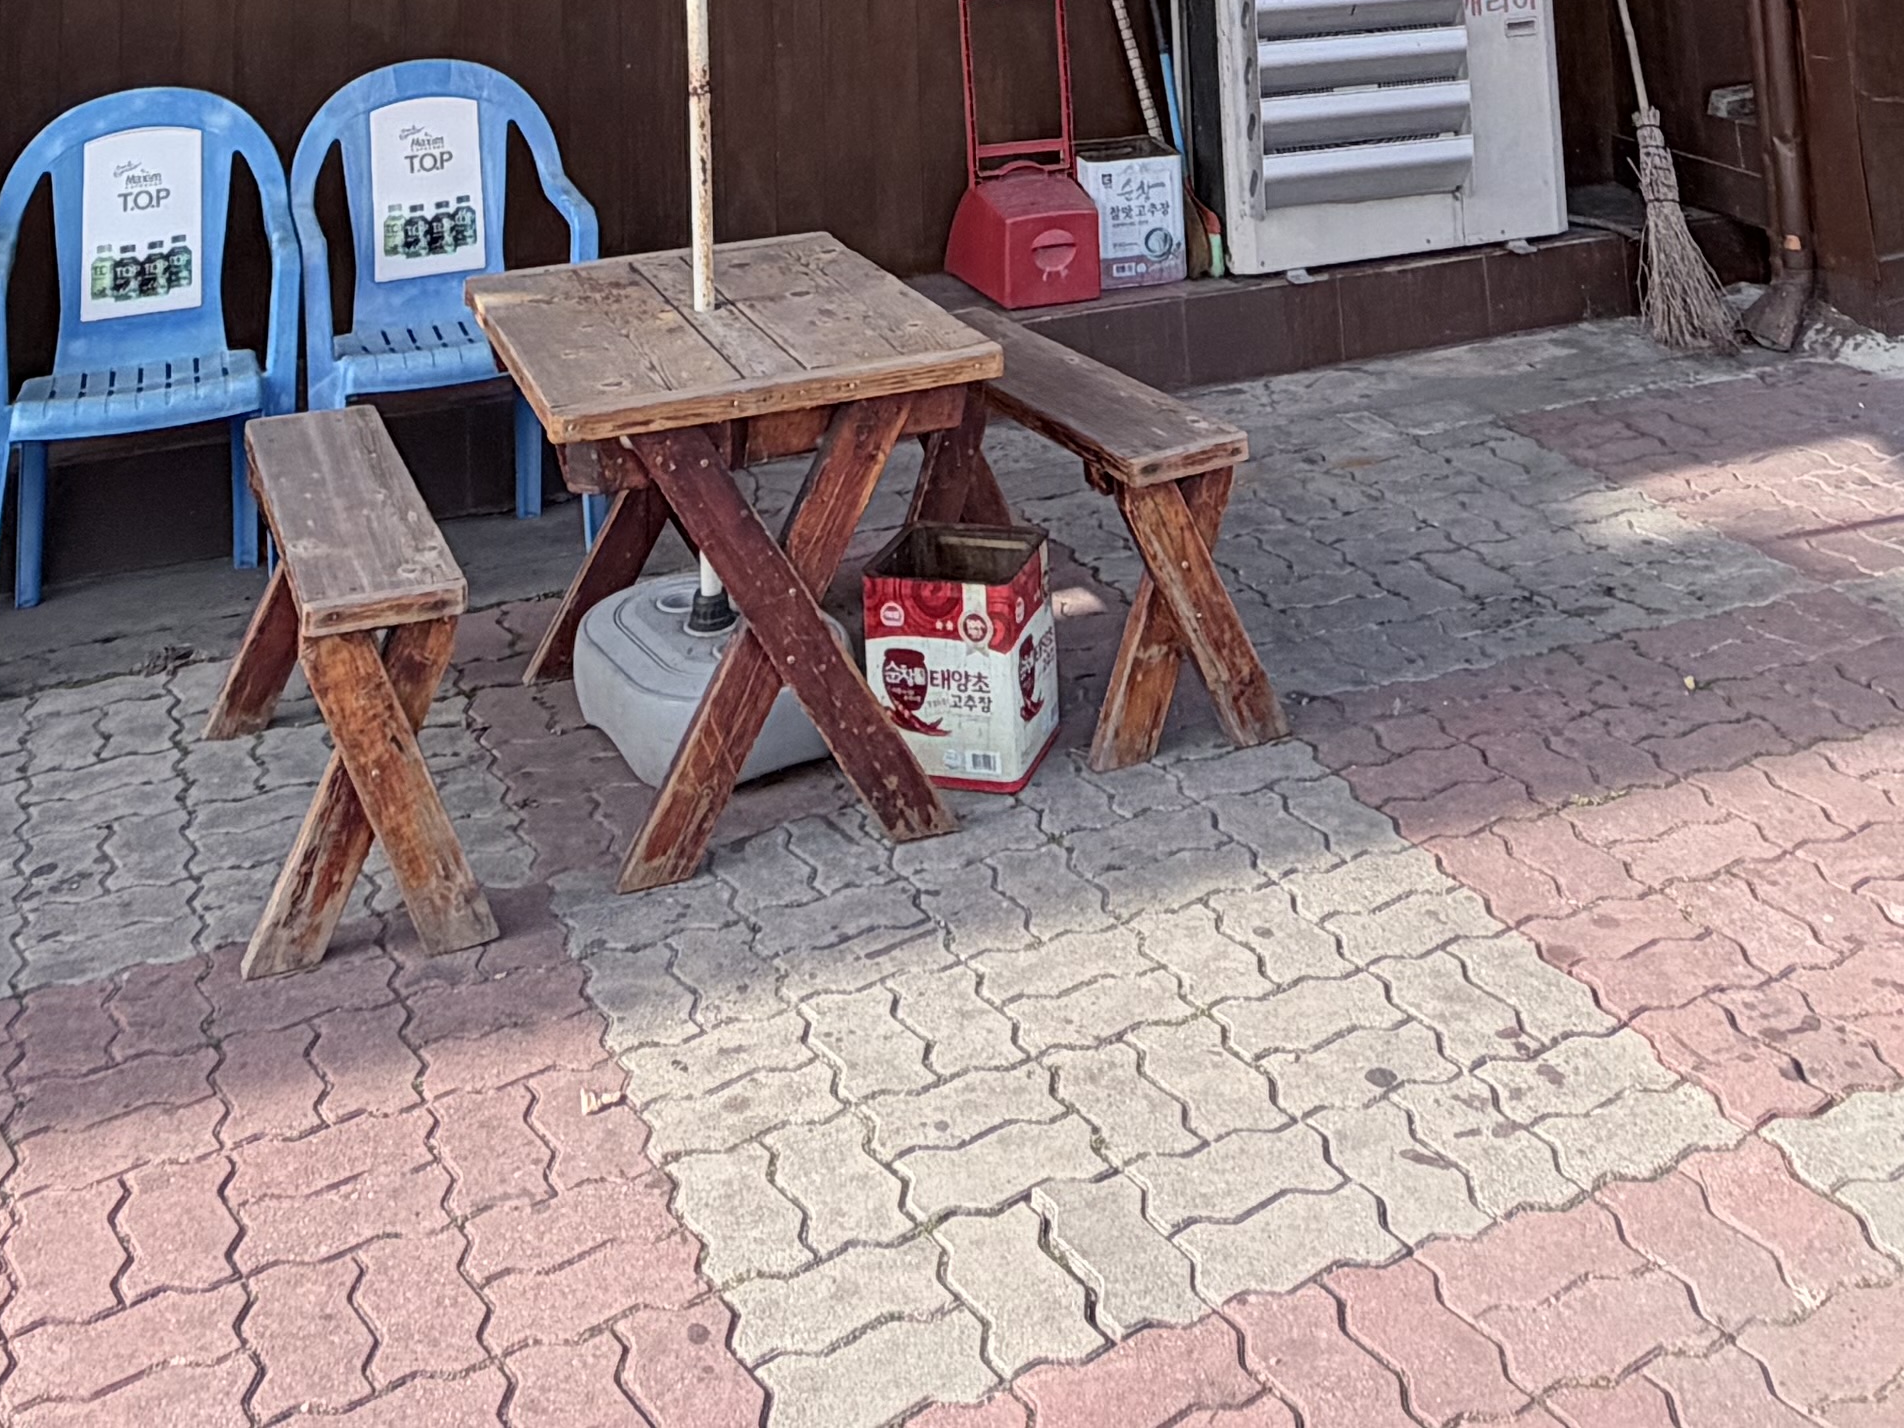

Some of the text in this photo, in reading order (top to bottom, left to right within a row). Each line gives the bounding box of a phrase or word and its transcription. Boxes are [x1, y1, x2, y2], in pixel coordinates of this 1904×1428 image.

[410, 135, 445, 149] Maxim
[404, 150, 454, 175] T.O.P
[125, 172, 163, 186] Maxim
[116, 187, 171, 213] T.O.P
[929, 668, 992, 694] 태양초
[949, 693, 993, 713] 고추장
